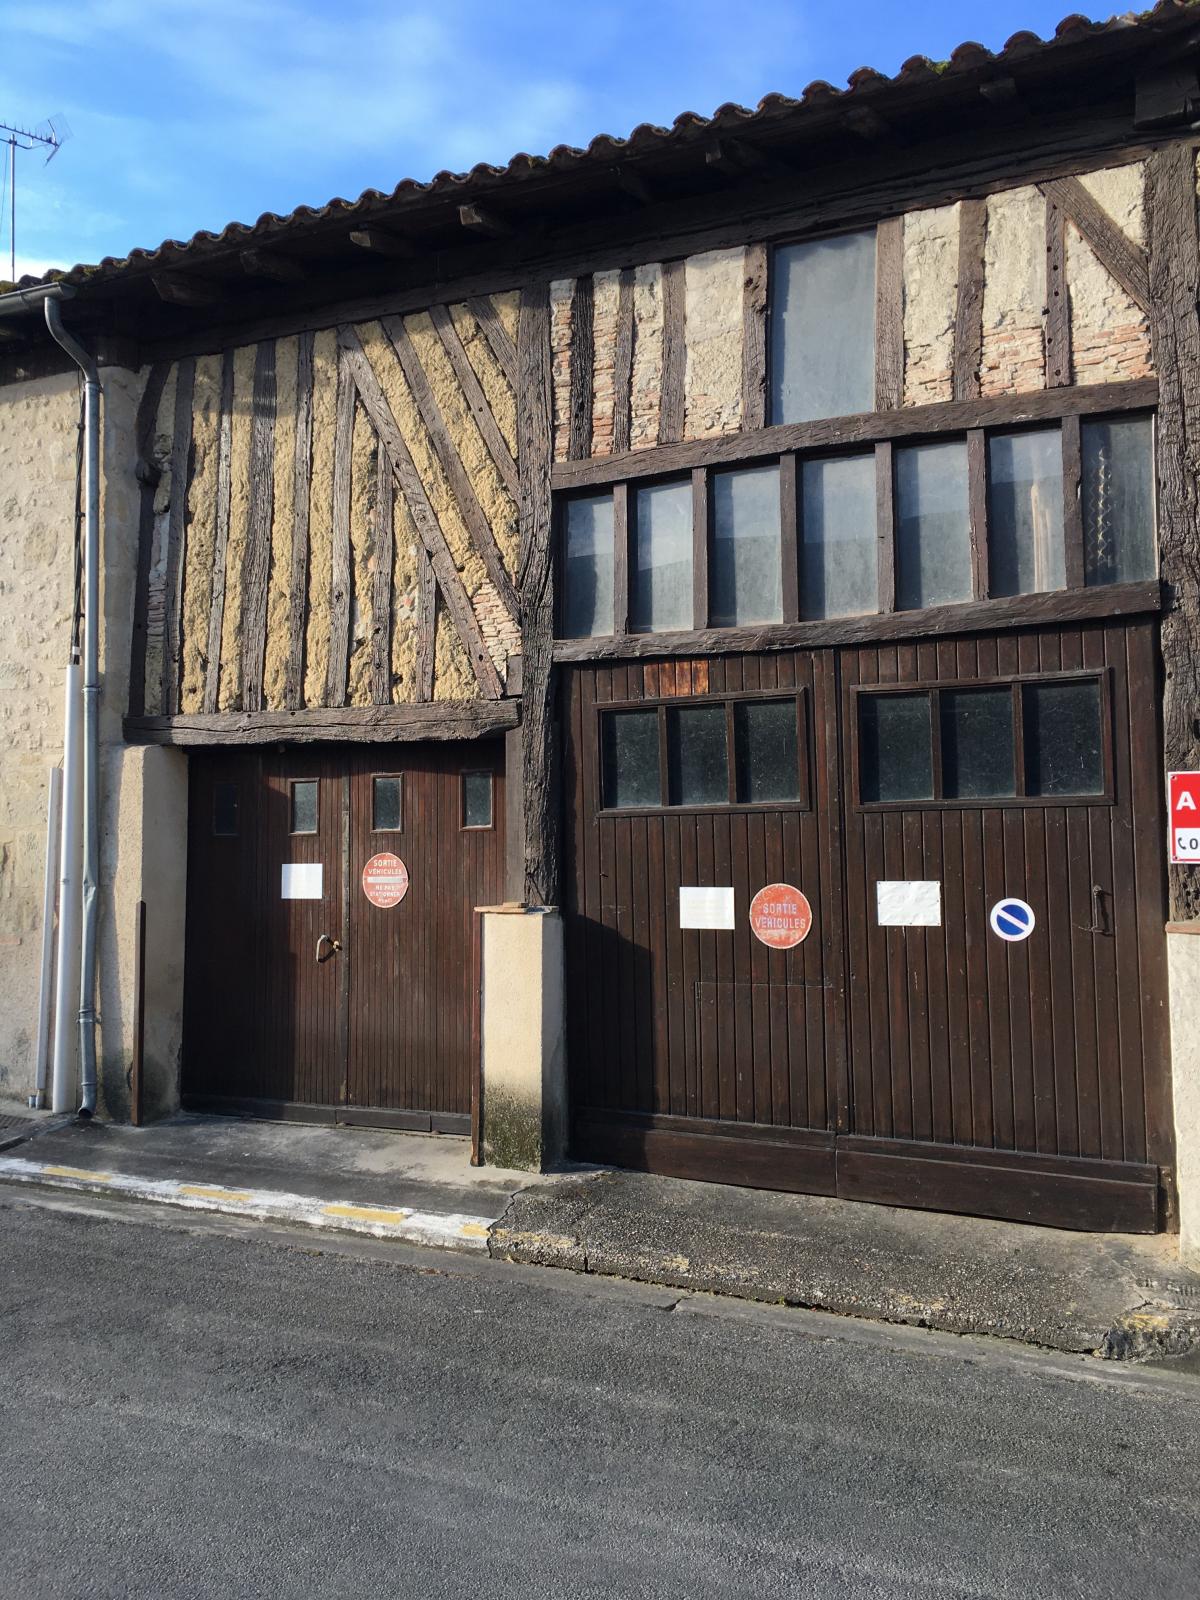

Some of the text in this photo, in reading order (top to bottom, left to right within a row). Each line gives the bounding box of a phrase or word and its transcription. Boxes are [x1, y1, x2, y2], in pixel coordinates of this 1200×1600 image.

[1176, 791, 1197, 811] A
[373, 859, 397, 867] SORTIE
[762, 903, 797, 914] SORTIE
